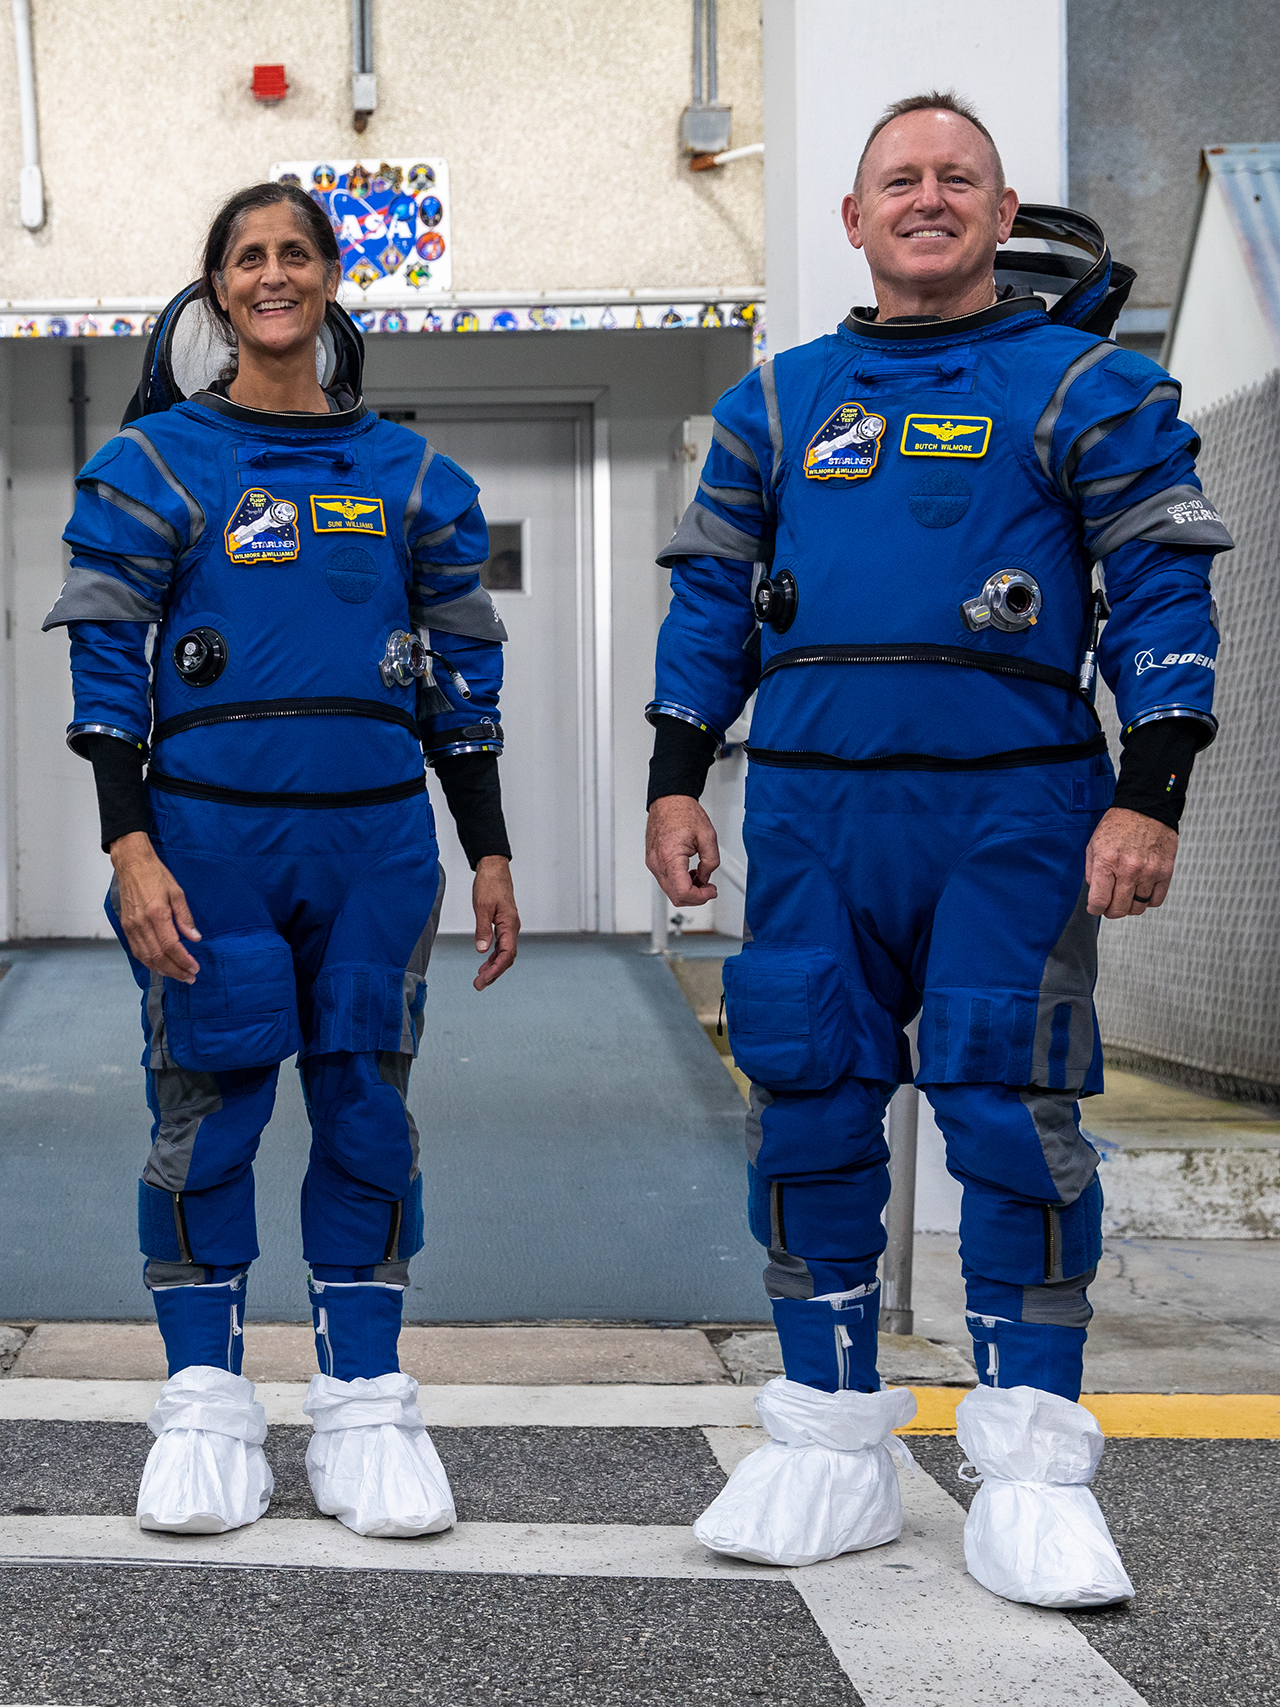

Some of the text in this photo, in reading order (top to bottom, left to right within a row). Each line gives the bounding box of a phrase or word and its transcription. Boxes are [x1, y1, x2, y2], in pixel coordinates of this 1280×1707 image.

[339, 214, 413, 240] ASA
[940, 444, 973, 452] WILMORE
[828, 457, 872, 465] STARLINER
[1167, 500, 1203, 514] CST-100
[345, 521, 374, 529] WILLIAMS
[251, 540, 295, 549] STARLINER
[1161, 653, 1216, 670] BOEIN
